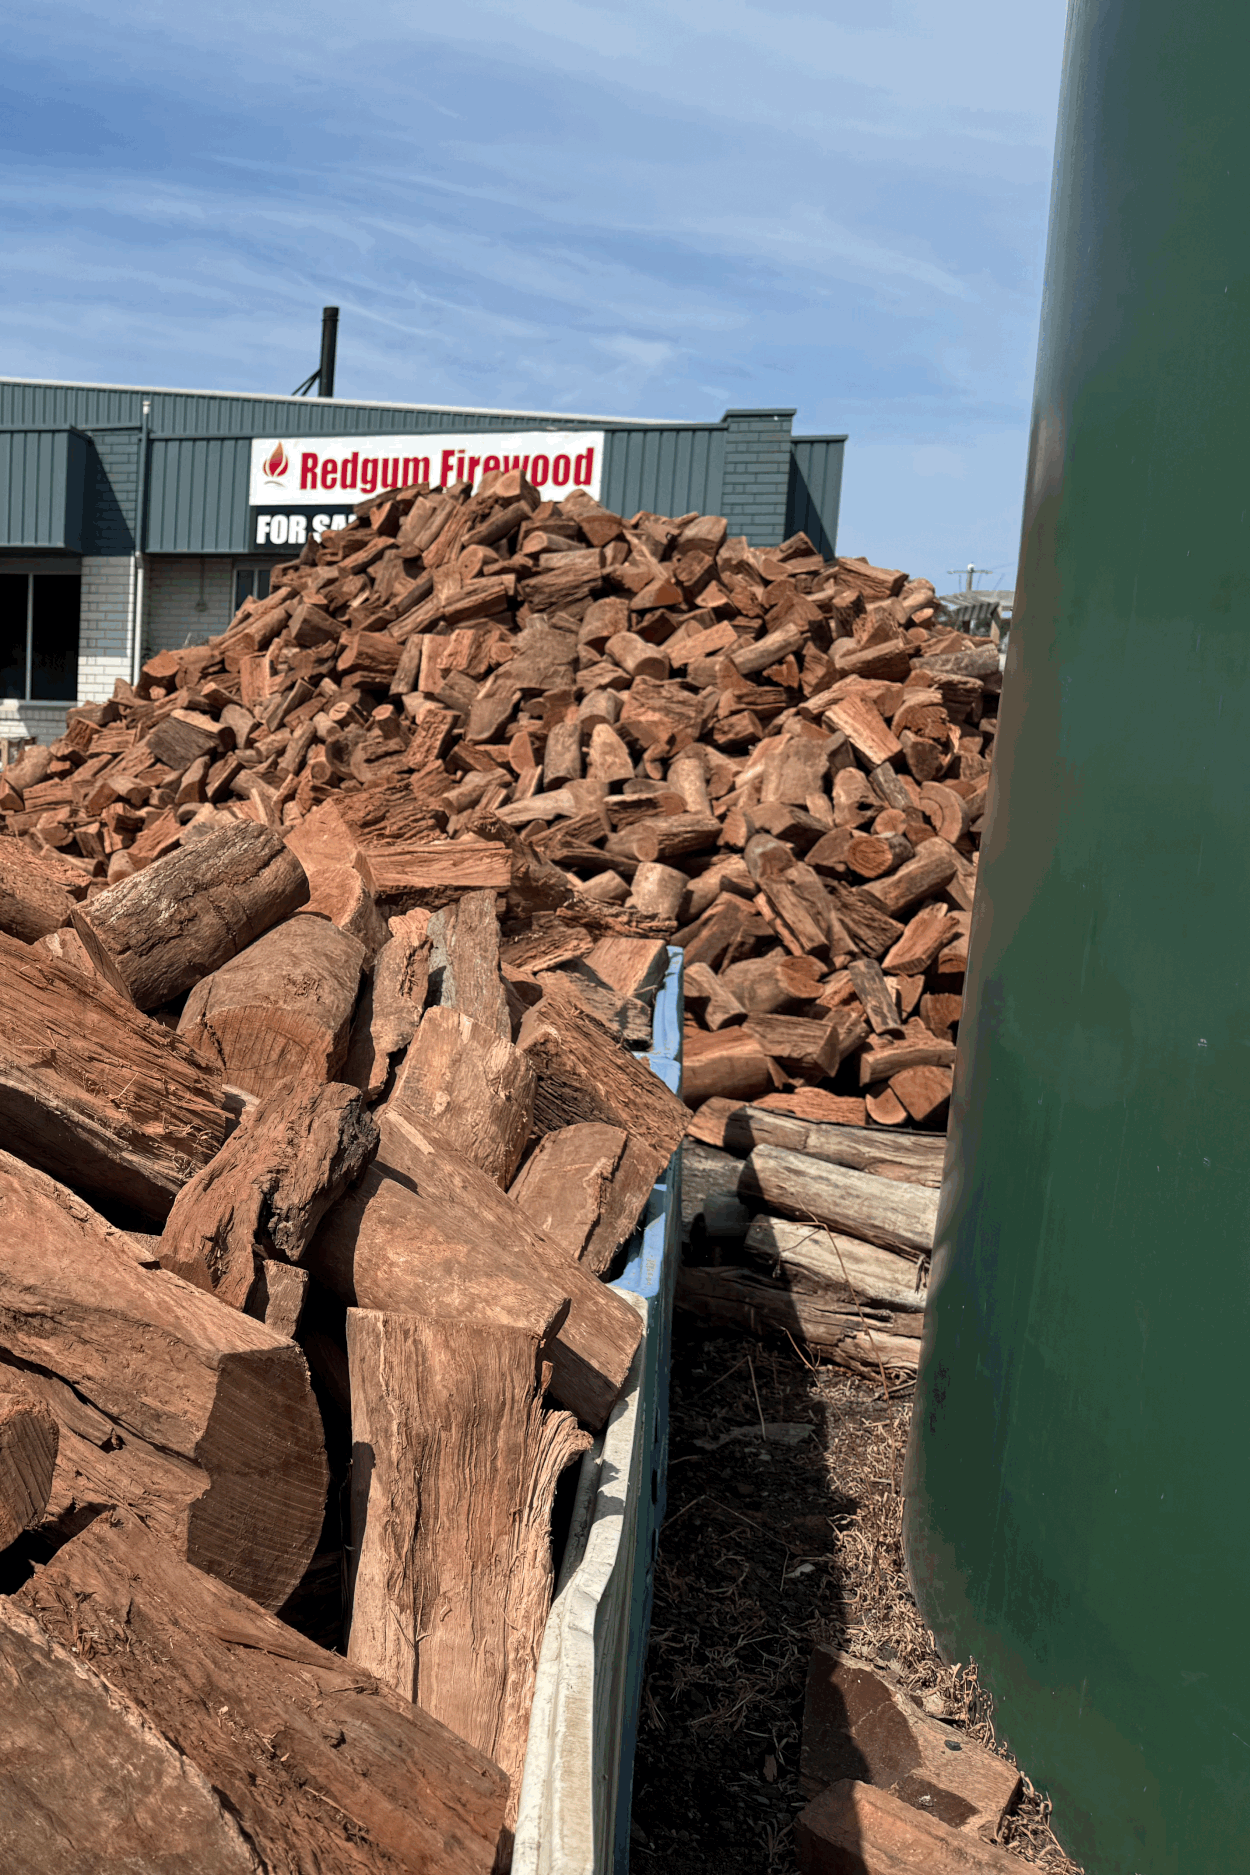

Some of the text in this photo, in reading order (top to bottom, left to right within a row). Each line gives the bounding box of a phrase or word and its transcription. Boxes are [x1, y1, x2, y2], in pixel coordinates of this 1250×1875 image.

[300, 447, 595, 493] Redgum Firewood
[256, 513, 357, 544] FOR SA
